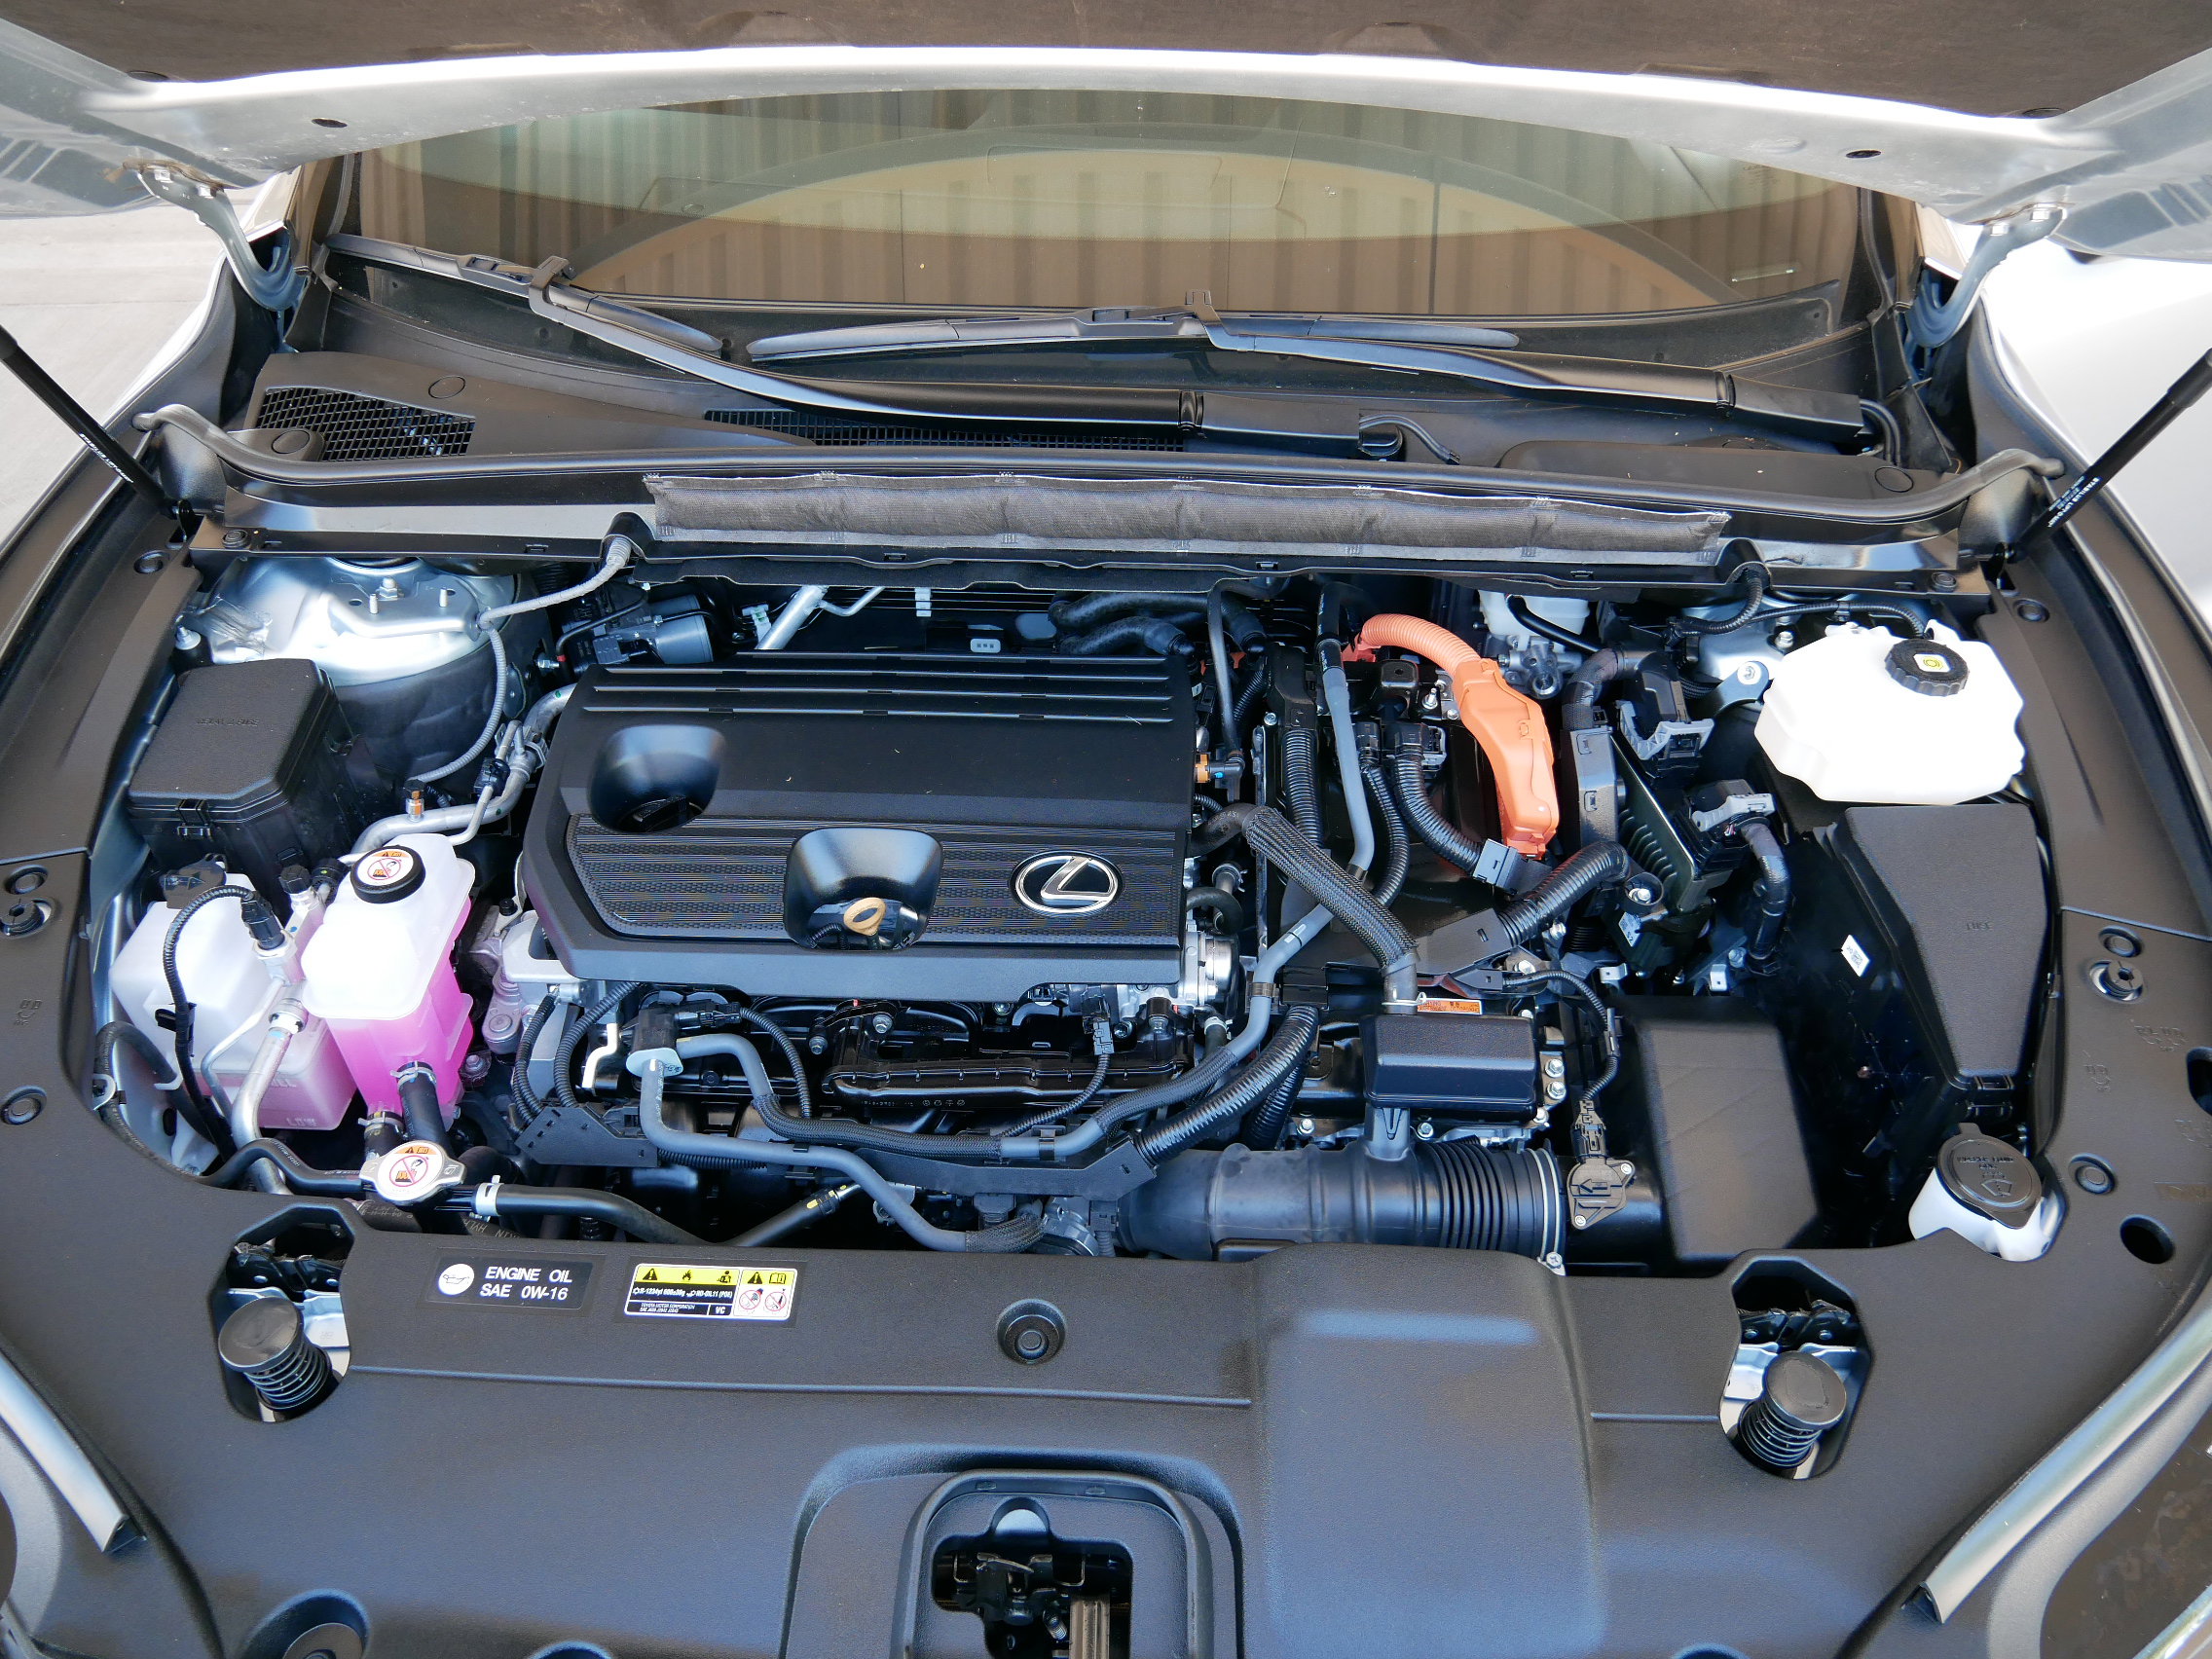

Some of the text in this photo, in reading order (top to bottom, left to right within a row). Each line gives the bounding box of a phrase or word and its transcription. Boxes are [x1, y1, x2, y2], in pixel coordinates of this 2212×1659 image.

[485, 1266, 572, 1283] ENGINE OIL
[480, 1283, 568, 1301] SAE 0W-16
[715, 1306, 726, 1314] VC
